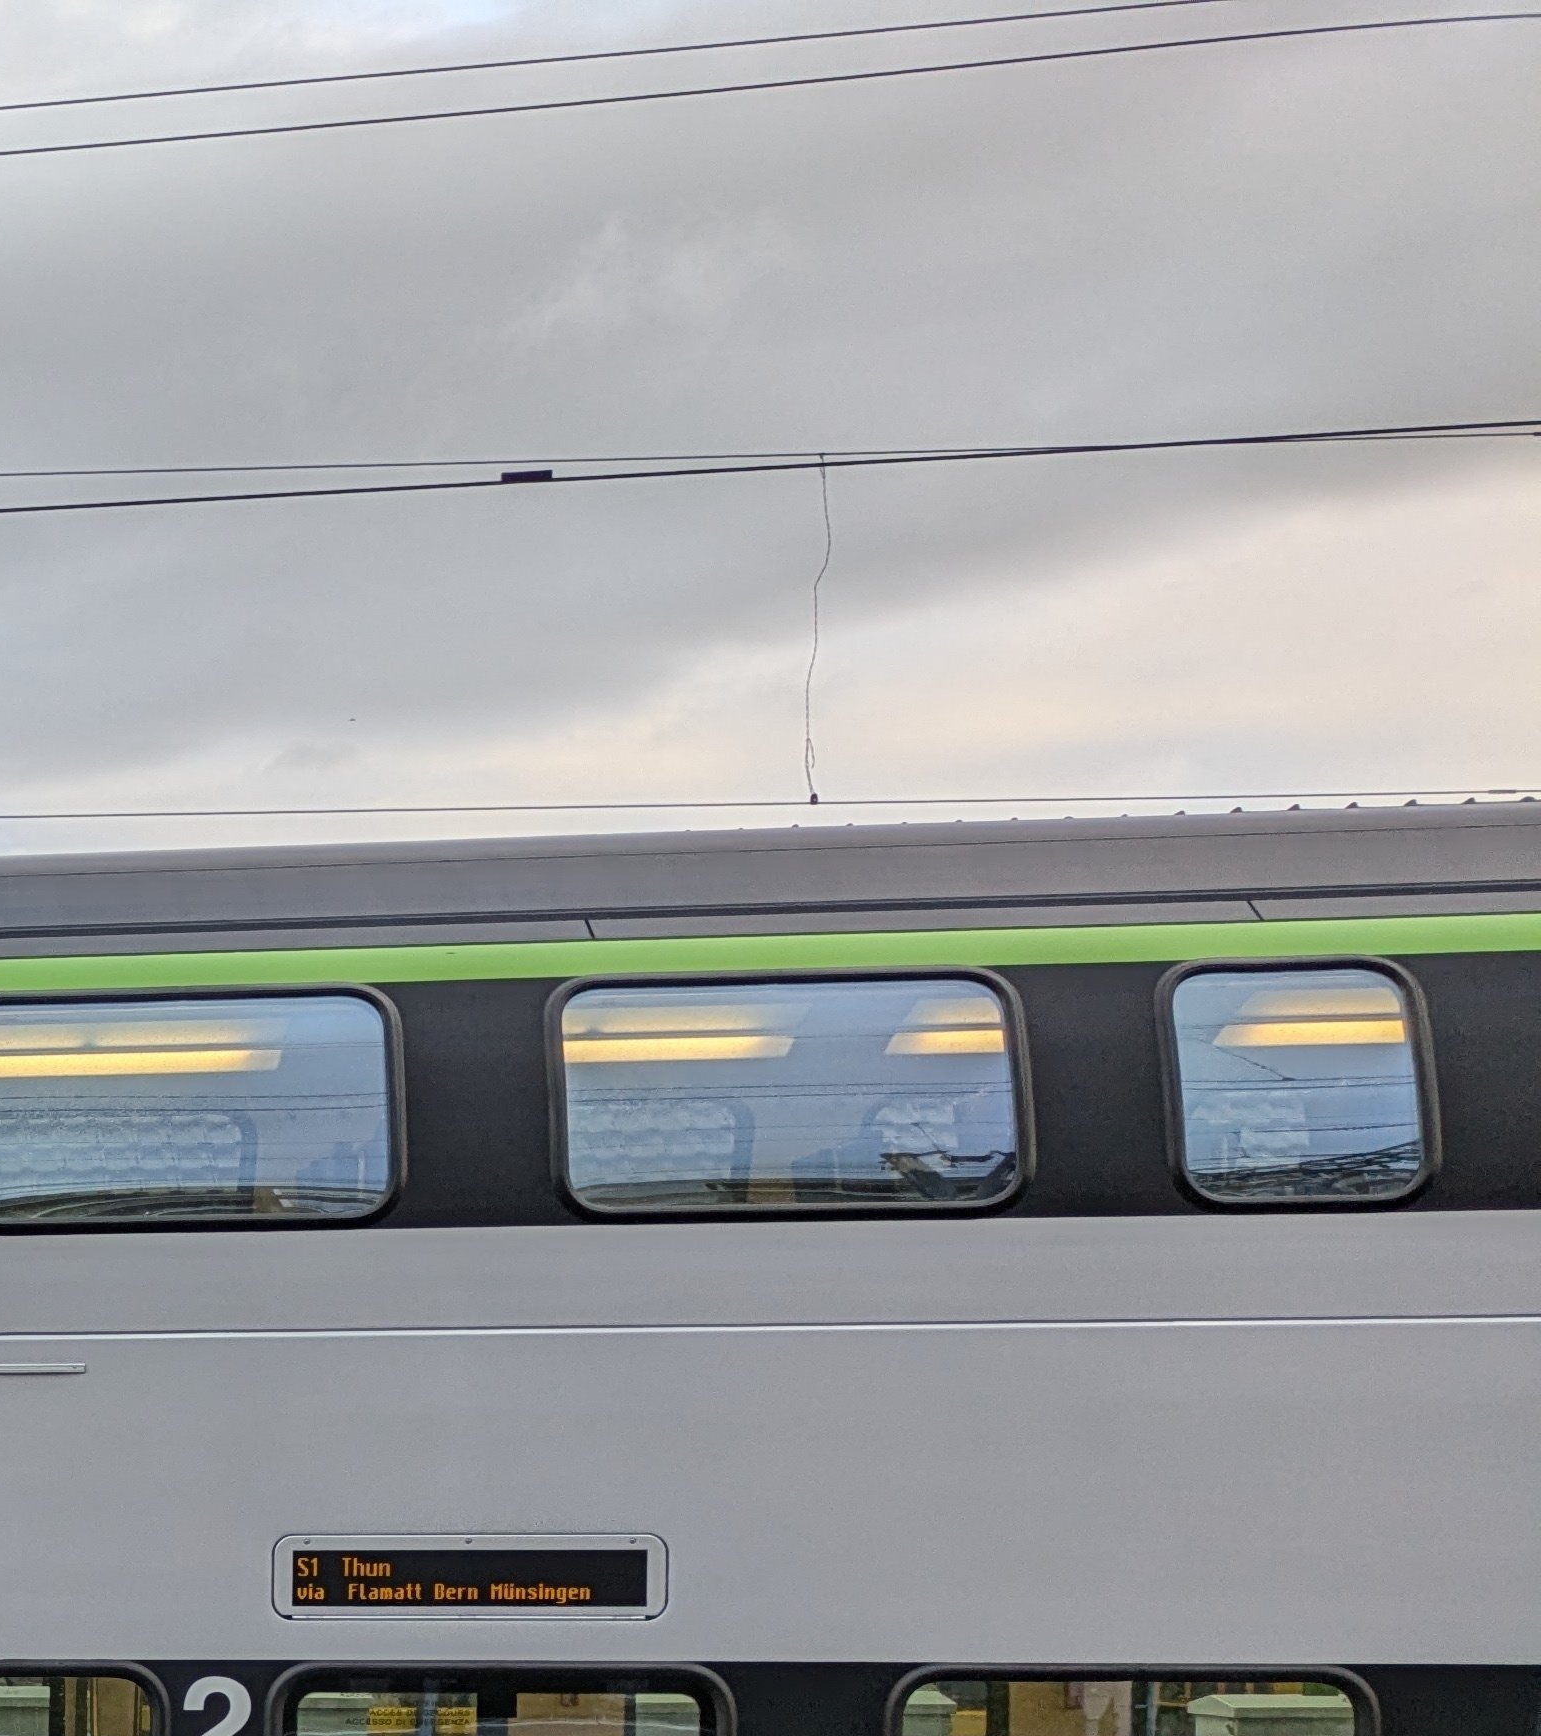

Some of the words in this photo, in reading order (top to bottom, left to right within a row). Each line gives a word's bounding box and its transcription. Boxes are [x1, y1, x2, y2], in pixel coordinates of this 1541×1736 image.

[297, 1557, 318, 1577] S1
[341, 1557, 392, 1577] Thun
[297, 1583, 325, 1600] via
[348, 1583, 423, 1600] Flamatt
[434, 1583, 479, 1600] Bern
[490, 1583, 591, 1604] Münsingen
